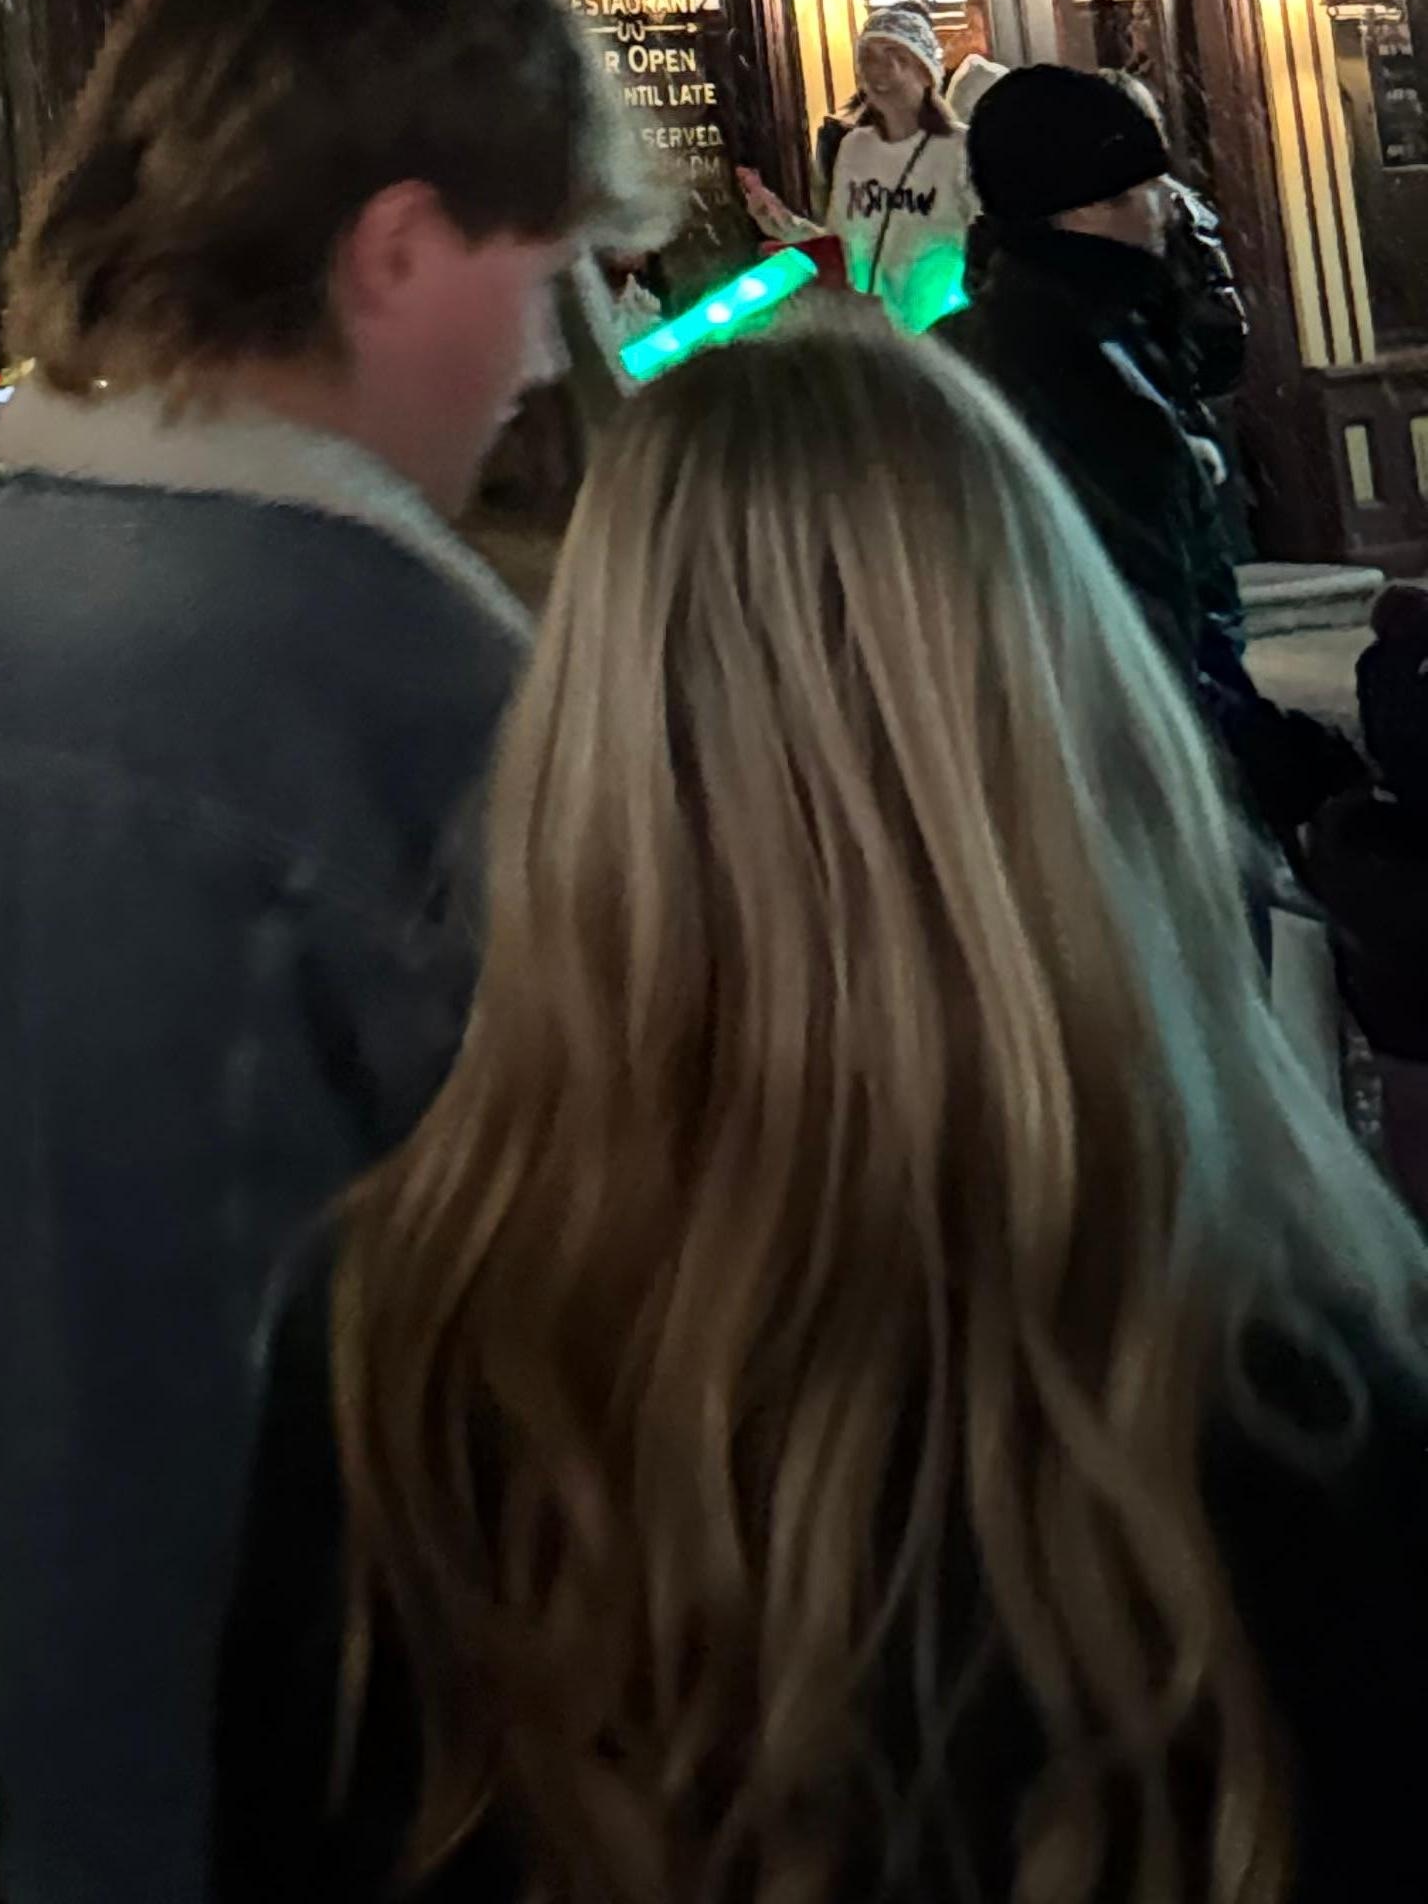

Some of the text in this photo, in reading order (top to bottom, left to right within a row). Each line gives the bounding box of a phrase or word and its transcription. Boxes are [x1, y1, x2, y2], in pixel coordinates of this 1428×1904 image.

[628, 45, 697, 73] OPEN
[623, 82, 717, 107] NTIL LATE
[641, 124, 724, 148] SERVED
